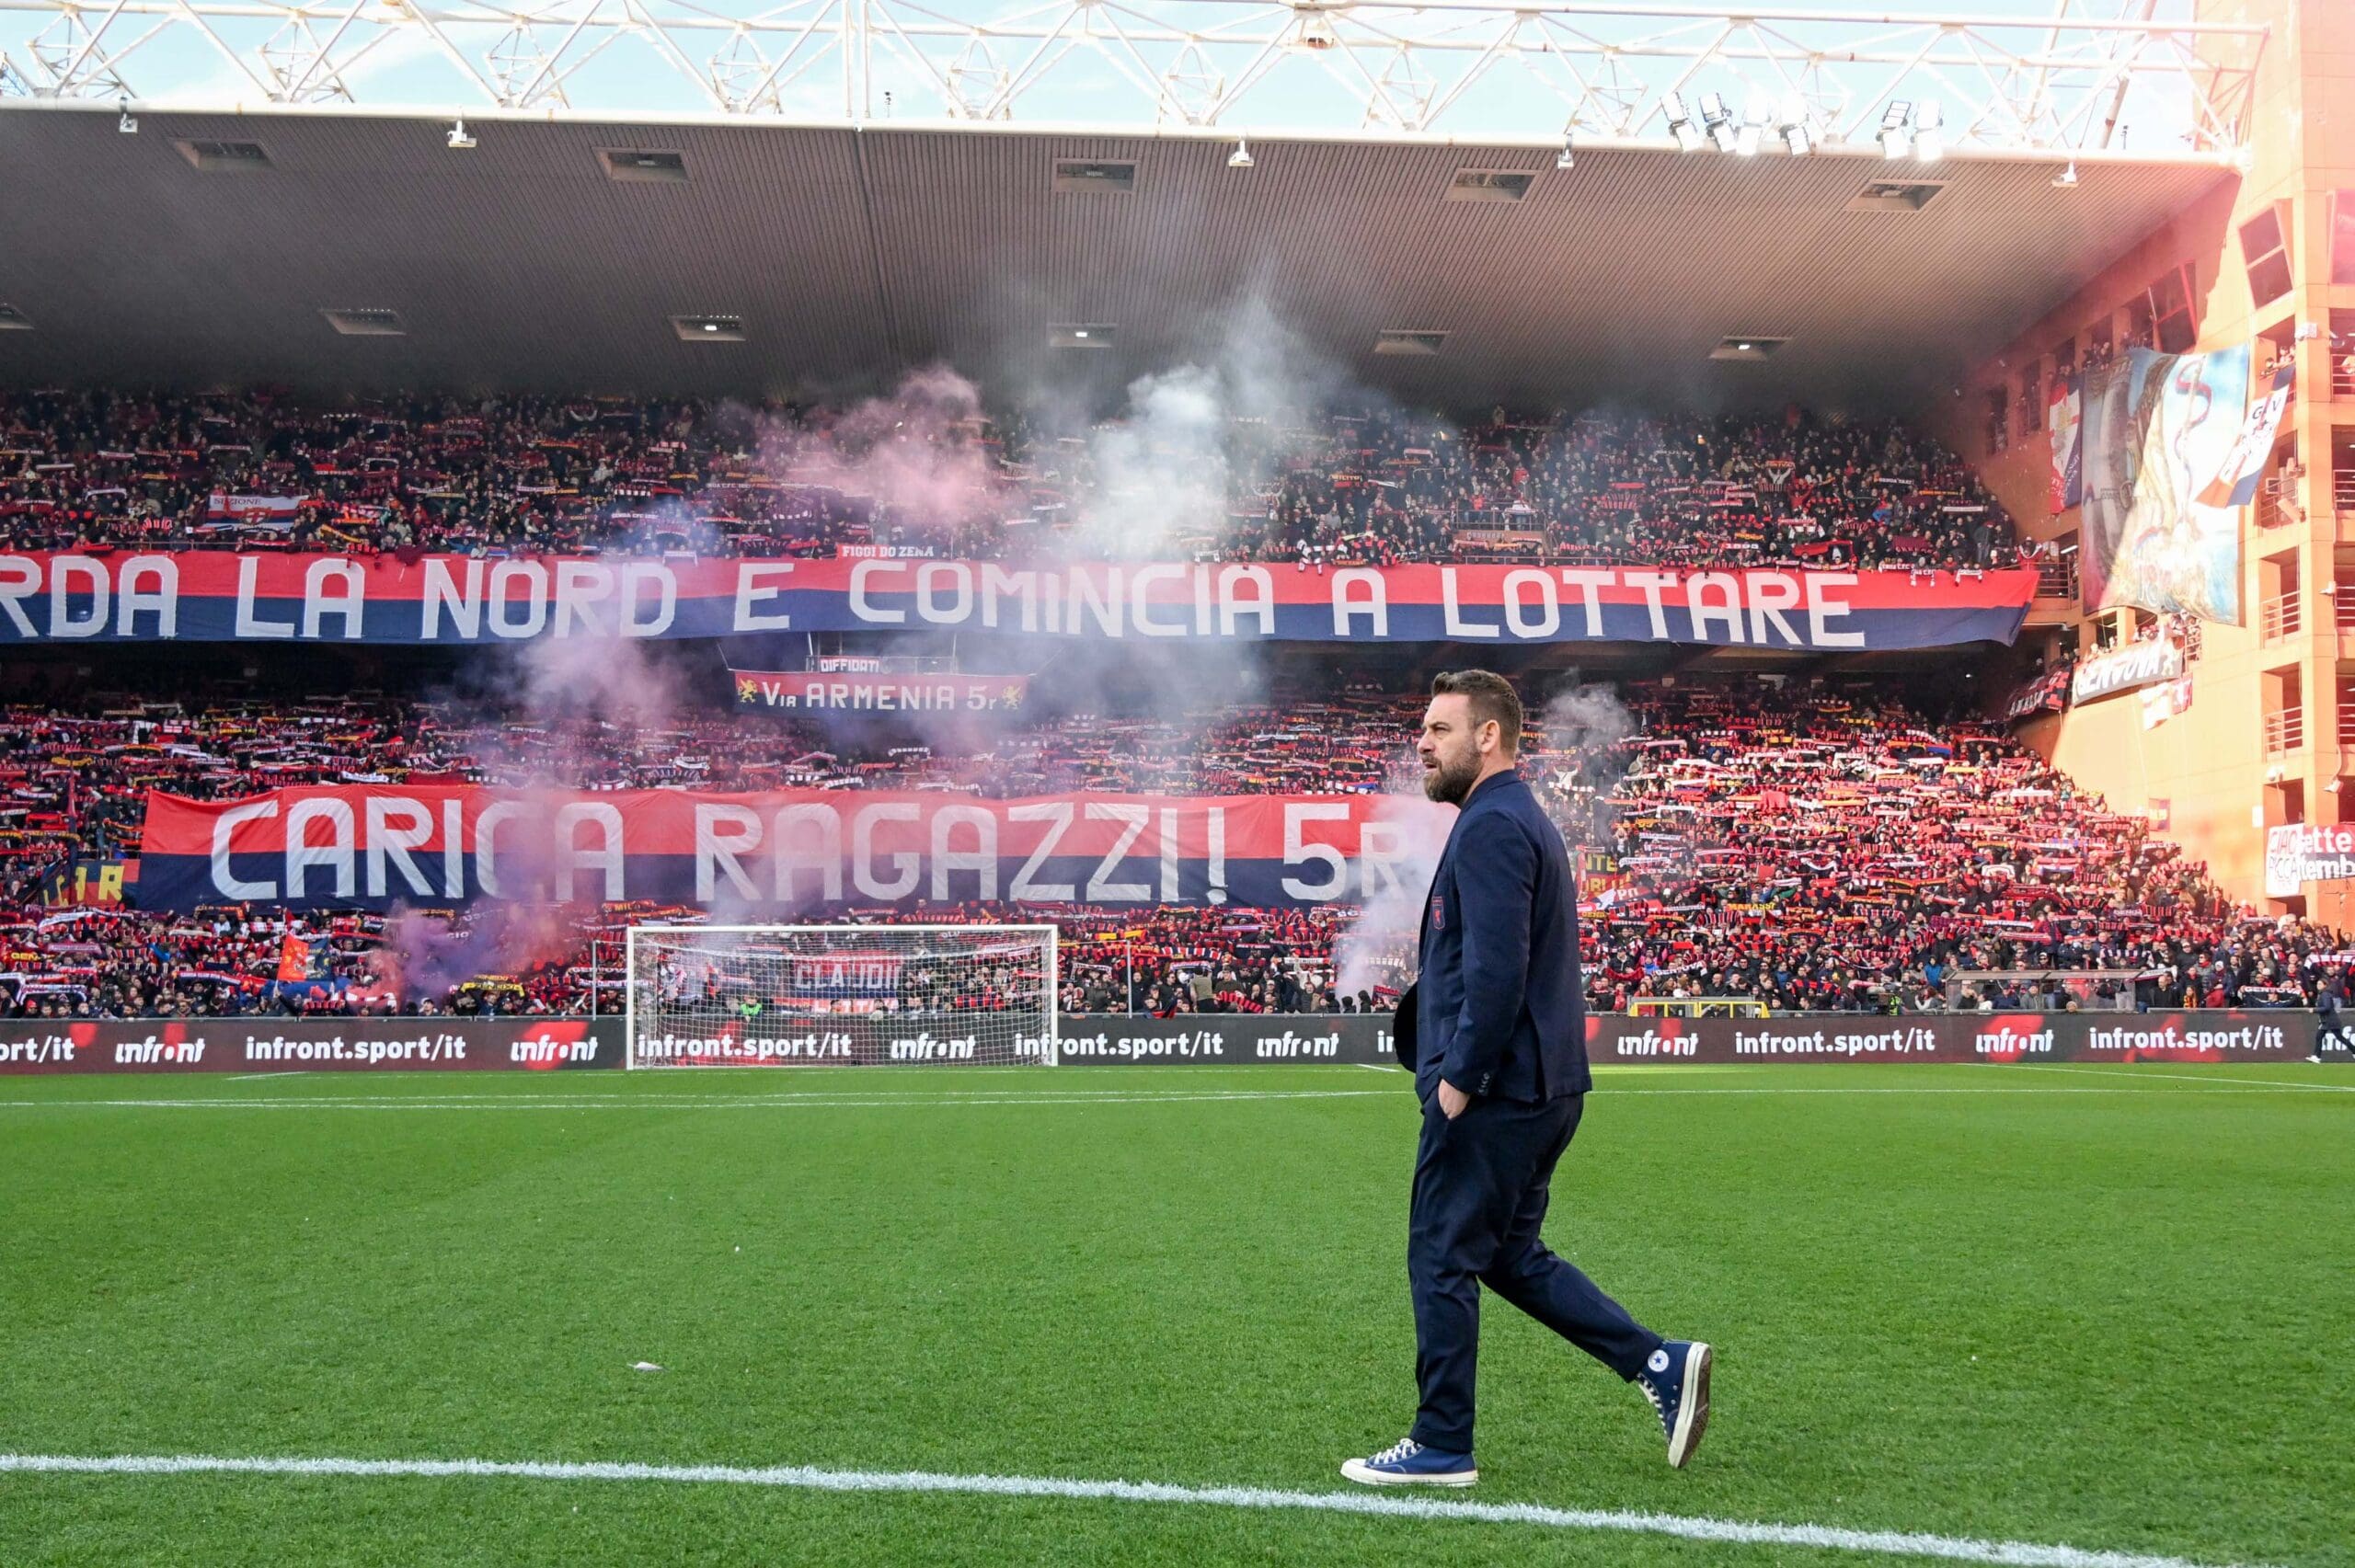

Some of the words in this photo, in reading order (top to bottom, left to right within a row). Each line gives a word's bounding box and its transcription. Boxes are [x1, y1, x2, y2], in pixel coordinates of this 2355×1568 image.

[842, 545, 876, 557] FIGGI
[879, 545, 897, 557] DO
[899, 546, 935, 557] ZENA
[236, 555, 365, 639] LA
[421, 558, 677, 640] NORD
[733, 562, 795, 632] E
[848, 560, 1274, 638] COMINCIA
[1334, 570, 1389, 637] A
[1442, 567, 1867, 647] LOTTARE
[806, 682, 956, 711] ARMENIA
[210, 797, 625, 900] CARICA
[695, 802, 1227, 905] RAGAZZI!
[246, 1035, 466, 1064] infront.sport/it
[638, 1034, 852, 1060] infront.sport/it
[1735, 1025, 1936, 1056] infront.sport/it
[2089, 1024, 2283, 1052] infront.sport/it
